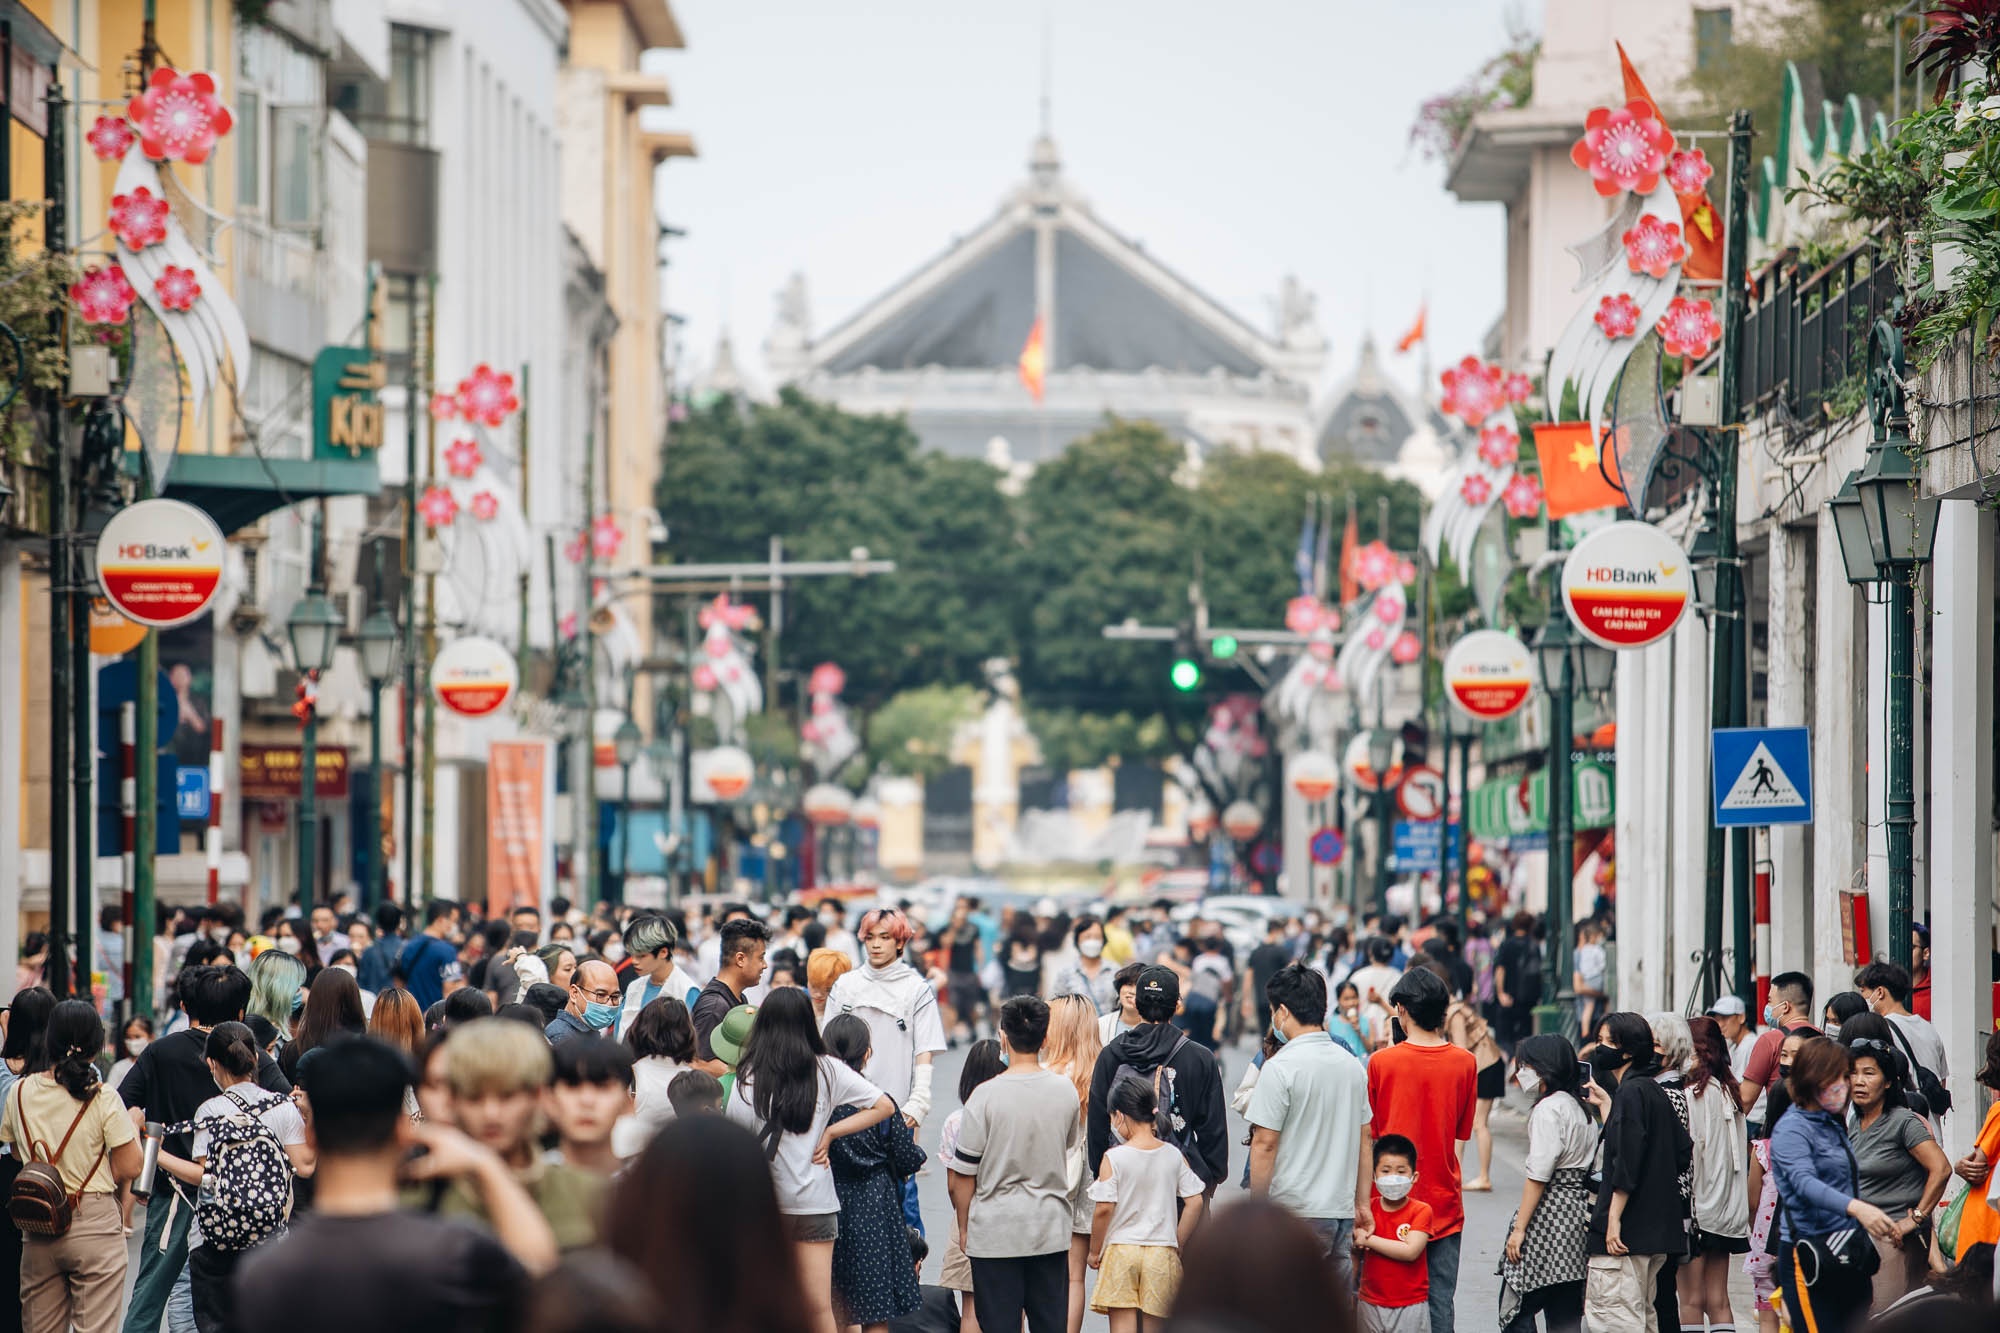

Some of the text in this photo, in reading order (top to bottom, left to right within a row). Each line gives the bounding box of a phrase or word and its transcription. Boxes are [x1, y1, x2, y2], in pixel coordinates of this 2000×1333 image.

[118, 543, 190, 559] HDBank
[1587, 567, 1657, 584] HDBank
[1592, 606, 1613, 617] CAM
[1604, 619, 1623, 630] CAO
